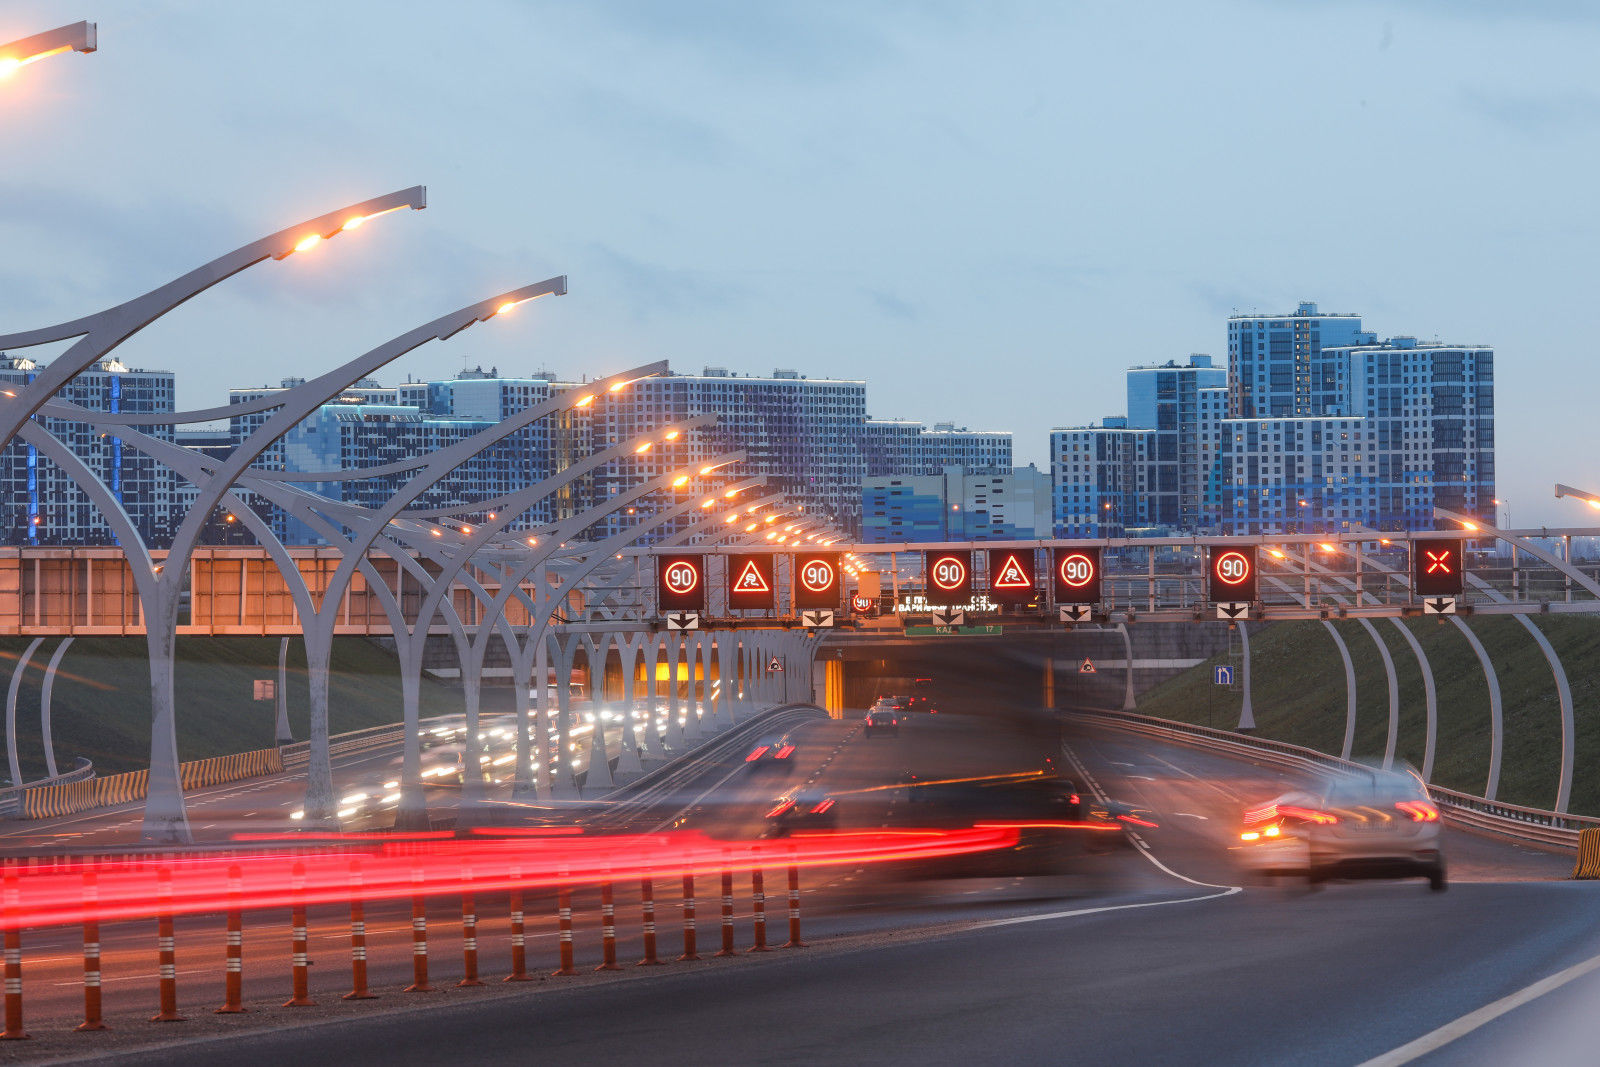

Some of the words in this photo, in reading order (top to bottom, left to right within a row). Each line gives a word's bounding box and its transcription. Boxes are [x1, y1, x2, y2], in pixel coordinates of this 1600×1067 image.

[808, 568, 827, 584] 90
[940, 565, 958, 581] 90
[1068, 562, 1087, 579] 90
[1223, 560, 1242, 576] 90
[672, 569, 691, 585] 90
